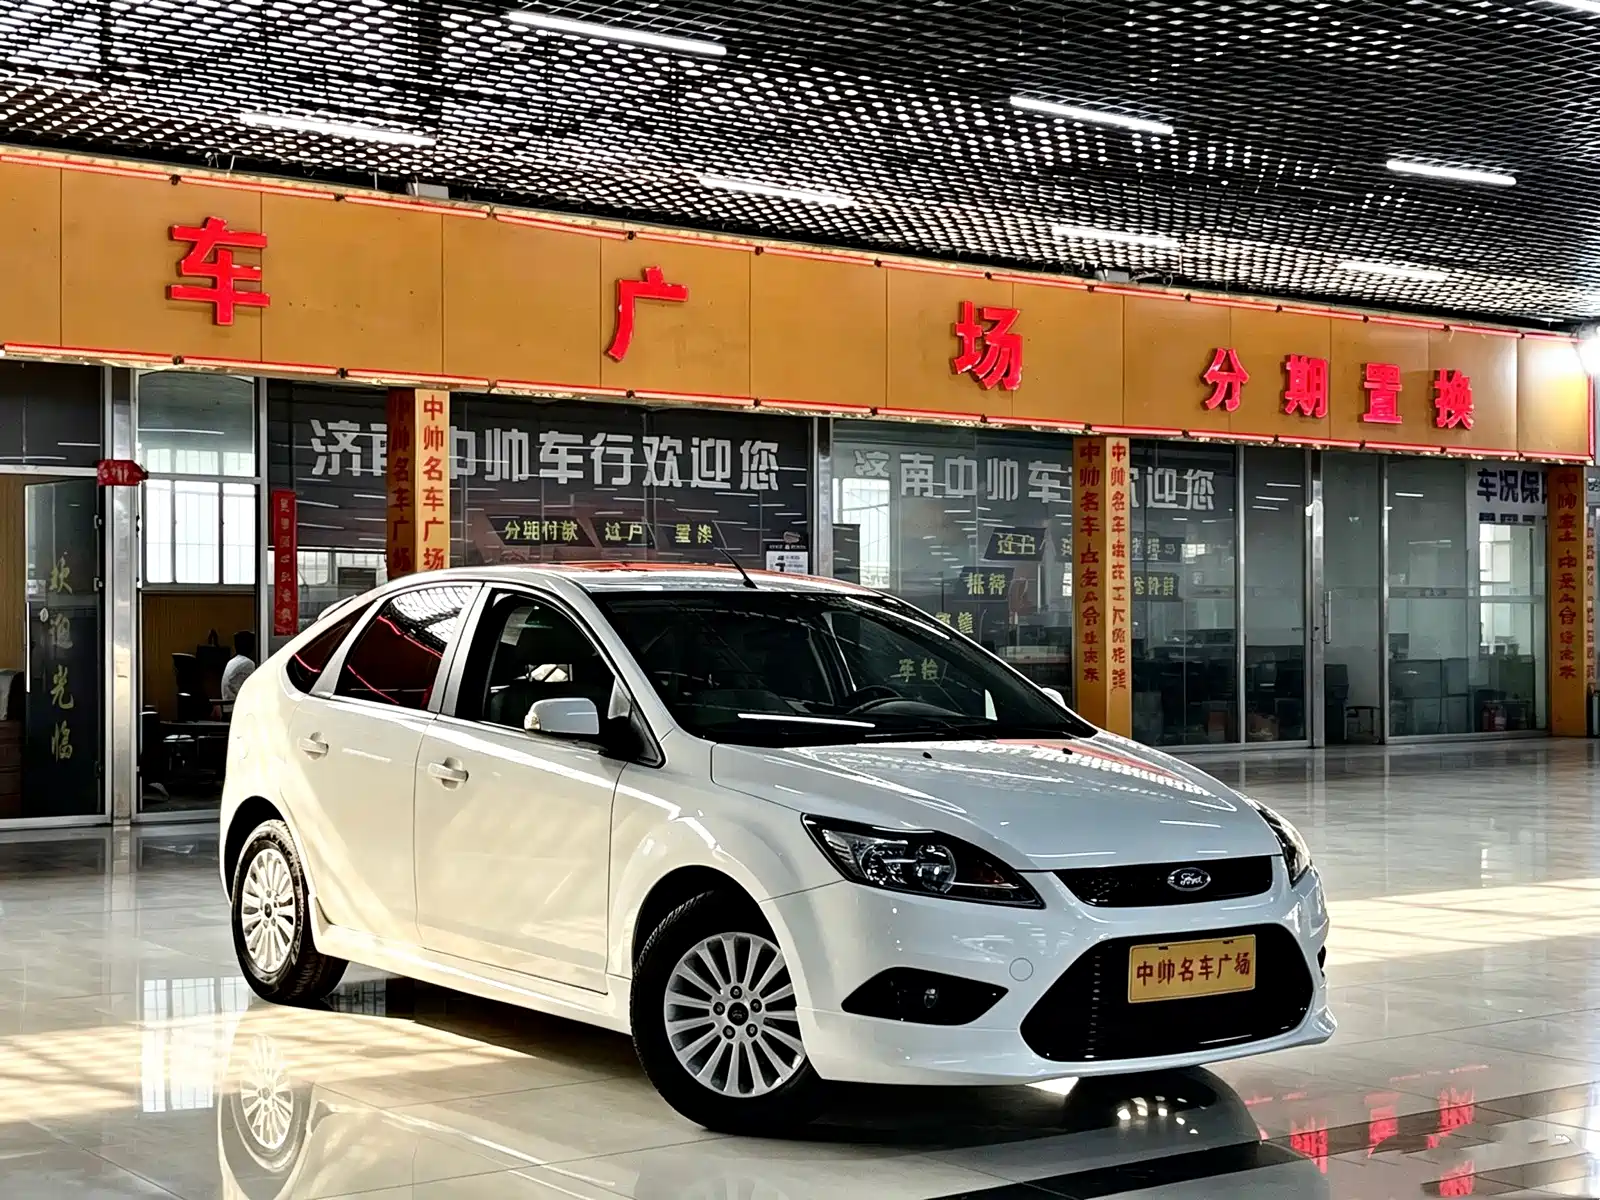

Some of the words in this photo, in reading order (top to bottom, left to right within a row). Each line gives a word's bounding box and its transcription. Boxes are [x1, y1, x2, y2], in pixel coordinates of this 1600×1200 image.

[422, 394, 444, 569] 中帅名车广场
[1179, 872, 1204, 886] Ford
[1136, 951, 1251, 987] 中帅名车广场
